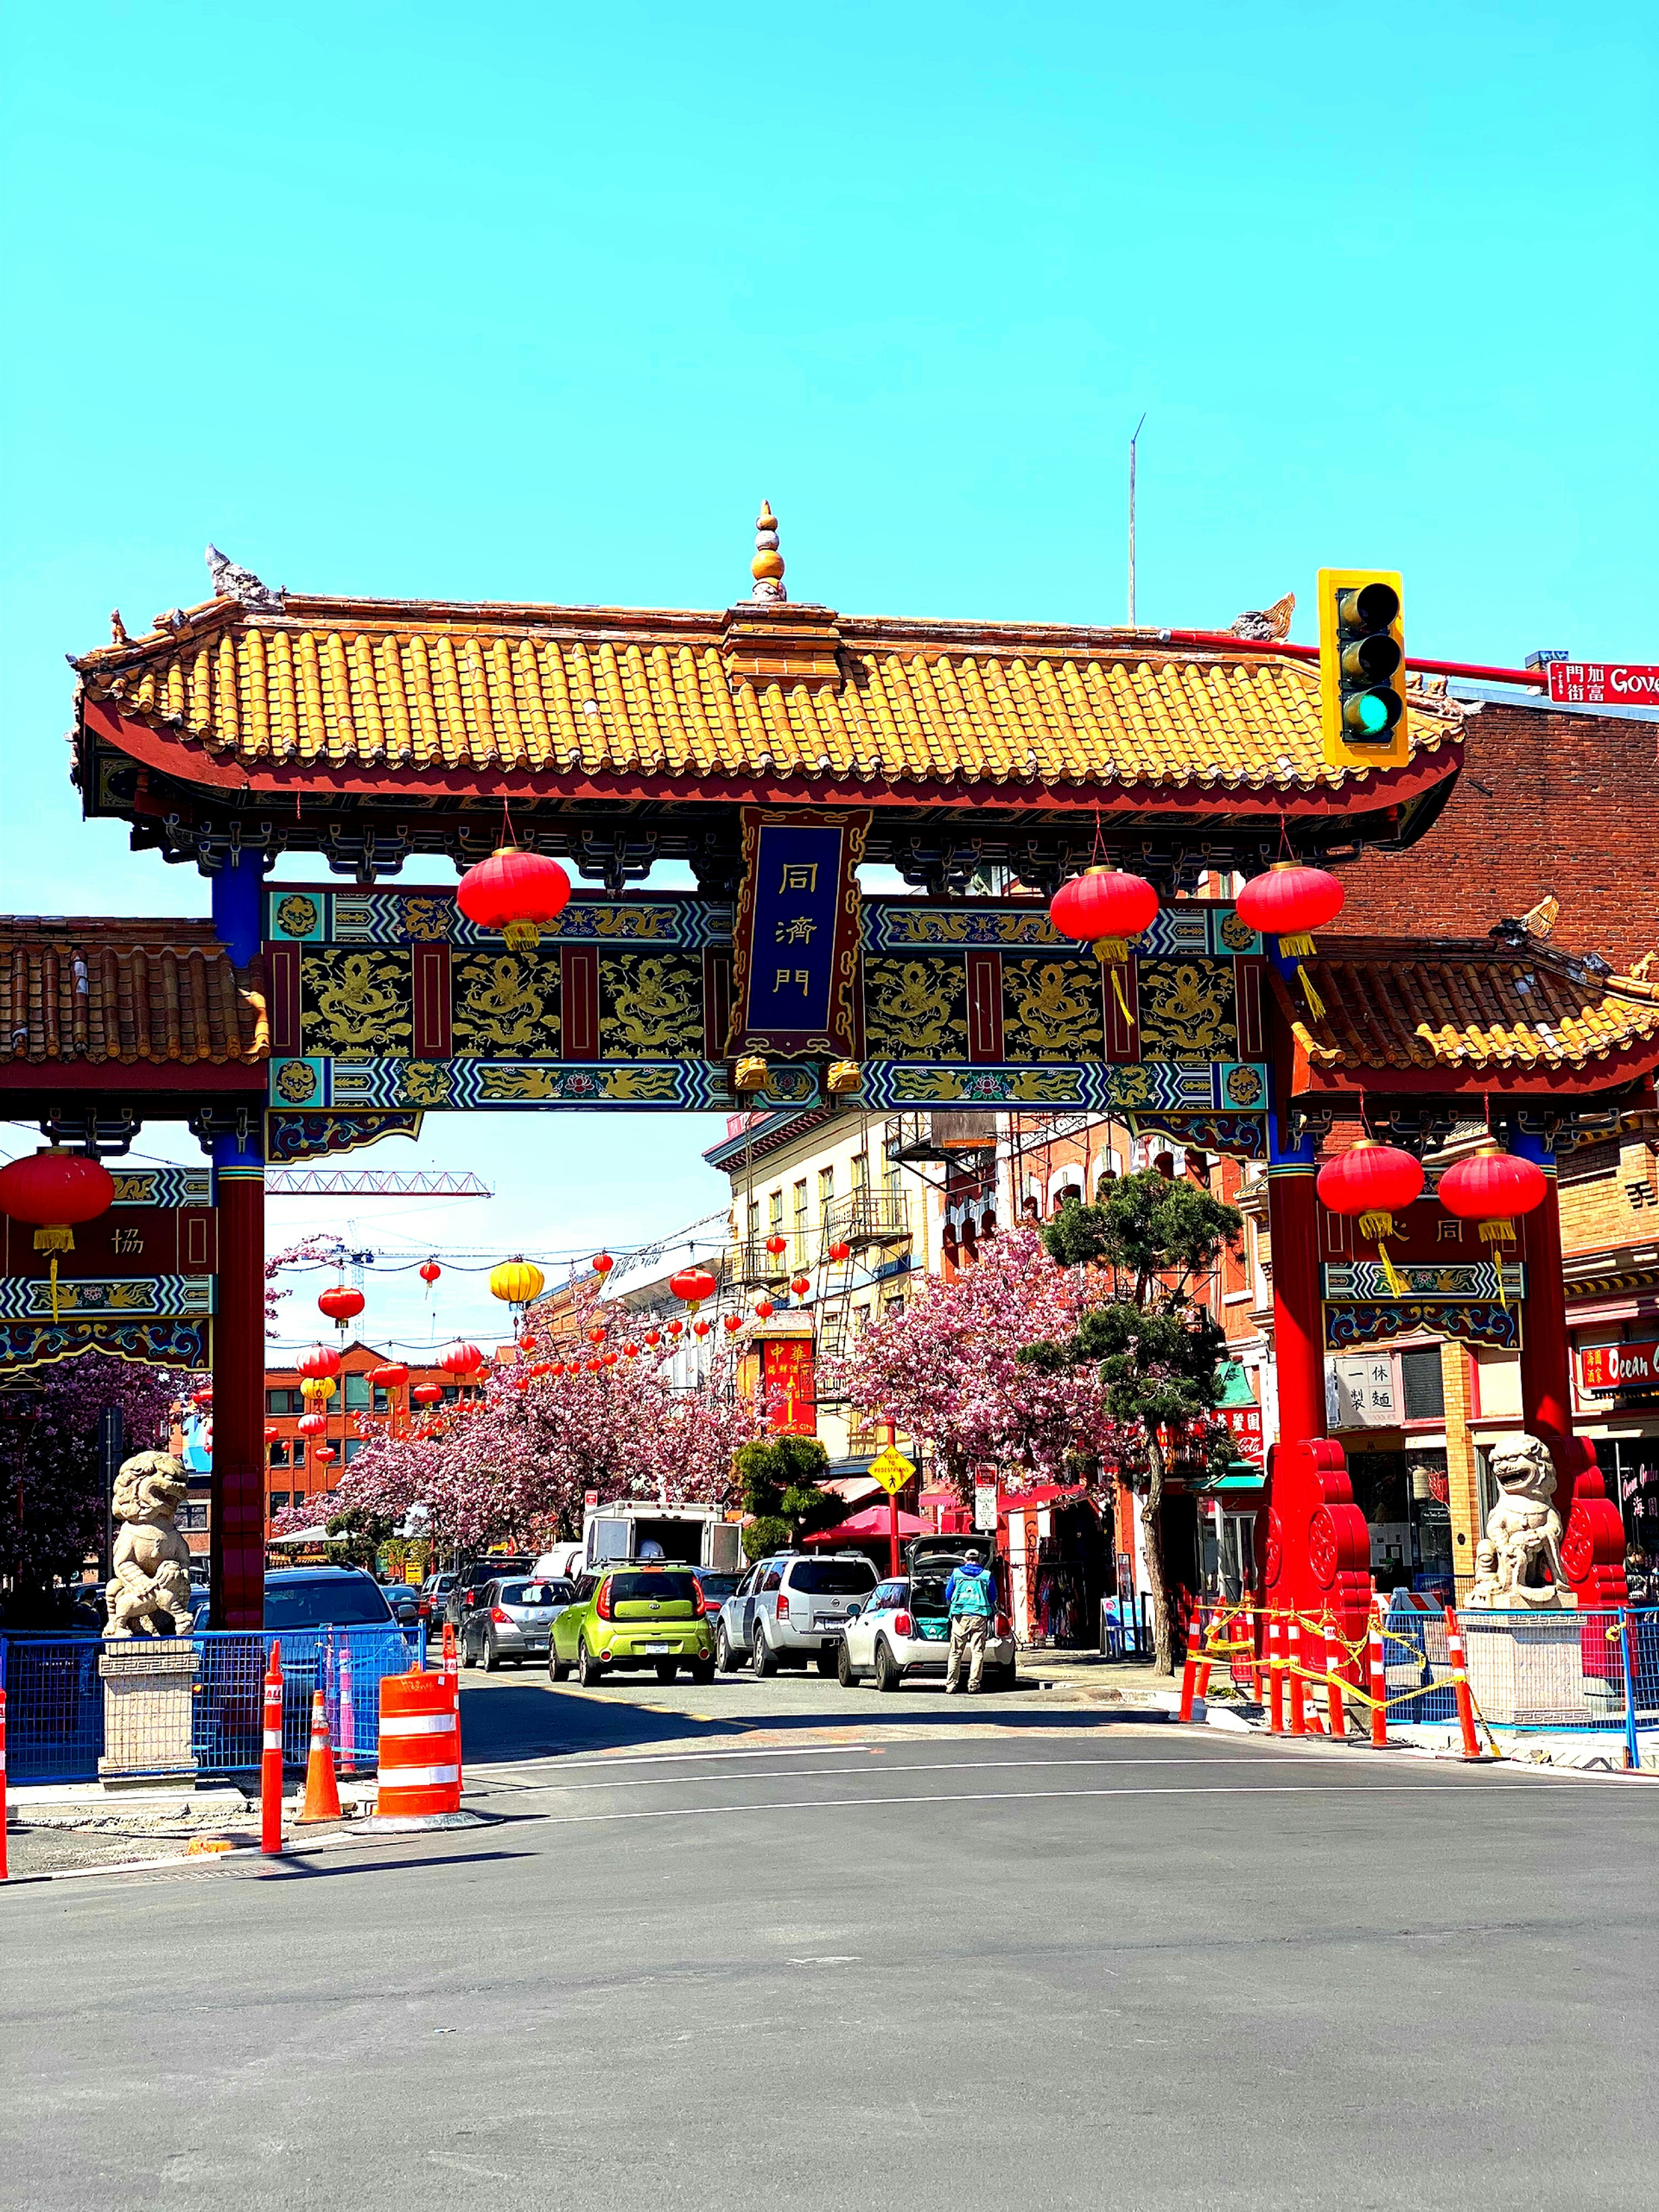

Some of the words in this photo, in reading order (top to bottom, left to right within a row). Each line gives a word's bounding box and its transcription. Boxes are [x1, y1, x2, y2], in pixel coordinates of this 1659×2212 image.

[772, 863, 818, 997] 同濟門
[111, 1229, 144, 1254] 協
[770, 1343, 807, 1364] 中華
[1609, 1348, 1648, 1379] Ocean
[799, 1423, 814, 1432] City
